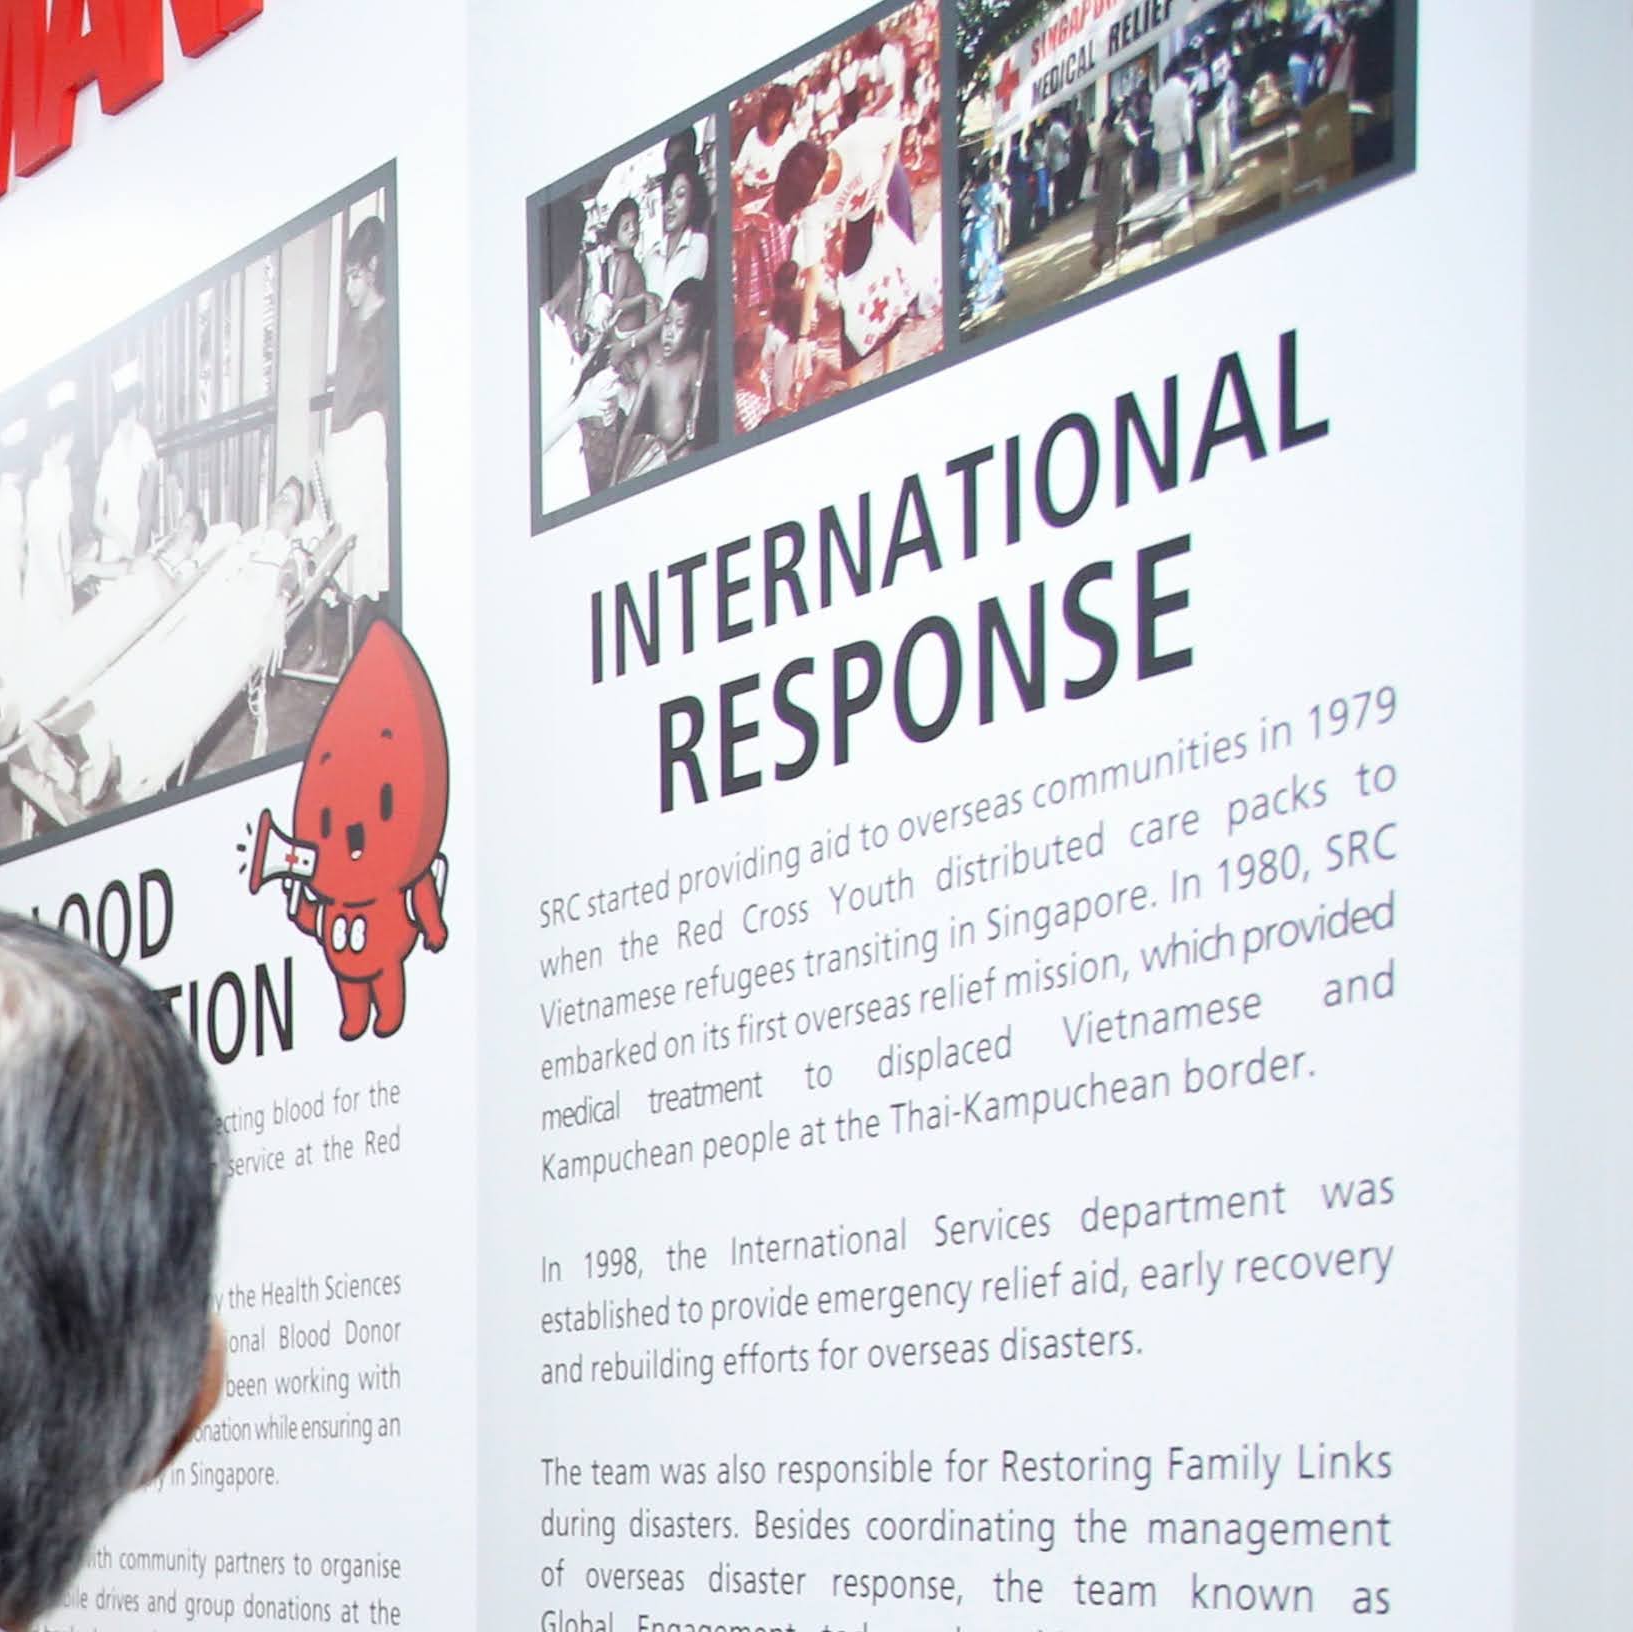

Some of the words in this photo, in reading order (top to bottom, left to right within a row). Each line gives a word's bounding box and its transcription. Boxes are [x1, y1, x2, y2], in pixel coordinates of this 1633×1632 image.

[589, 327, 1330, 685] INTERNATIONAL
[659, 533, 1194, 813] RESPONSE
[539, 892, 582, 929] SRC
[586, 868, 670, 918] started
[678, 844, 801, 905] providing
[809, 823, 851, 865] aid
[858, 823, 889, 852] to
[897, 788, 1024, 843] overseas
[1032, 730, 1248, 809] communities
[1260, 716, 1292, 753] in
[1308, 685, 1397, 740] 1979
[539, 982, 677, 1030] Vietnamese
[683, 957, 796, 1000] refugees
[803, 927, 938, 978] transiting
[950, 915, 976, 949] in
[986, 884, 1157, 942] Singapore.
[1171, 869, 1201, 904] In
[1217, 843, 1310, 893] 1980,
[1325, 821, 1398, 873] SRC
[540, 1031, 657, 1081] embarked
[663, 1032, 696, 1059] on
[702, 1021, 731, 1053] its
[736, 1011, 788, 1046] first
[794, 992, 912, 1036] overseas
[919, 965, 997, 1014] relief
[1004, 951, 1130, 999] mission,
[1139, 921, 1236, 973] which
[1242, 888, 1396, 965] provided
[272, 1090, 325, 1126] blood
[332, 1086, 361, 1115] for
[368, 1079, 401, 1109] the
[542, 1138, 694, 1183] Kampuchean
[702, 1119, 791, 1169] people
[798, 1116, 827, 1148] at
[833, 1107, 881, 1143] the
[888, 1071, 1171, 1135] Thai-Kampuchean
[1184, 1045, 1316, 1095] border.
[294, 1142, 314, 1168] at
[321, 1134, 355, 1163] the
[364, 1123, 401, 1157] Red
[541, 1255, 562, 1284] In
[584, 1245, 644, 1280] 1998,
[665, 1239, 708, 1273] the
[731, 1216, 907, 1266] International
[934, 1207, 1051, 1248] Services
[1080, 1181, 1287, 1240] department
[1320, 1175, 1395, 1210] was
[228, 1283, 257, 1311] the
[260, 1275, 320, 1307] Health
[324, 1272, 402, 1301] Sciences
[278, 1319, 331, 1351] Blood
[344, 1319, 402, 1346] Donor
[540, 1352, 584, 1385] and
[590, 1346, 715, 1386] rebuilding
[722, 1341, 810, 1376] efforts
[817, 1336, 860, 1372] for
[867, 1337, 990, 1369] overseas
[999, 1325, 1143, 1363] disasters.
[274, 1365, 350, 1400] working
[357, 1361, 401, 1391] with
[254, 1413, 299, 1441] while
[300, 1411, 374, 1447] ensuring
[377, 1416, 402, 1438] an
[539, 1456, 584, 1487] The
[590, 1459, 651, 1487] team
[659, 1462, 708, 1486] was
[716, 1452, 767, 1485] also
[777, 1448, 934, 1493] responsible
[944, 1447, 990, 1483] for
[1001, 1445, 1152, 1492] Restoring
[1167, 1441, 1282, 1491] Family
[1297, 1439, 1393, 1480] Links
[118, 1546, 208, 1580] community
[214, 1551, 286, 1580] partners
[292, 1552, 313, 1577] to
[319, 1551, 402, 1585] organise
[540, 1557, 566, 1588] of
[585, 1567, 686, 1593] overseas
[707, 1560, 808, 1596] disaster
[832, 1573, 964, 1607] response,
[992, 1567, 1045, 1605] the
[1071, 1573, 1157, 1608] team
[1190, 1571, 1314, 1613] known
[1351, 1586, 1391, 1616] as
